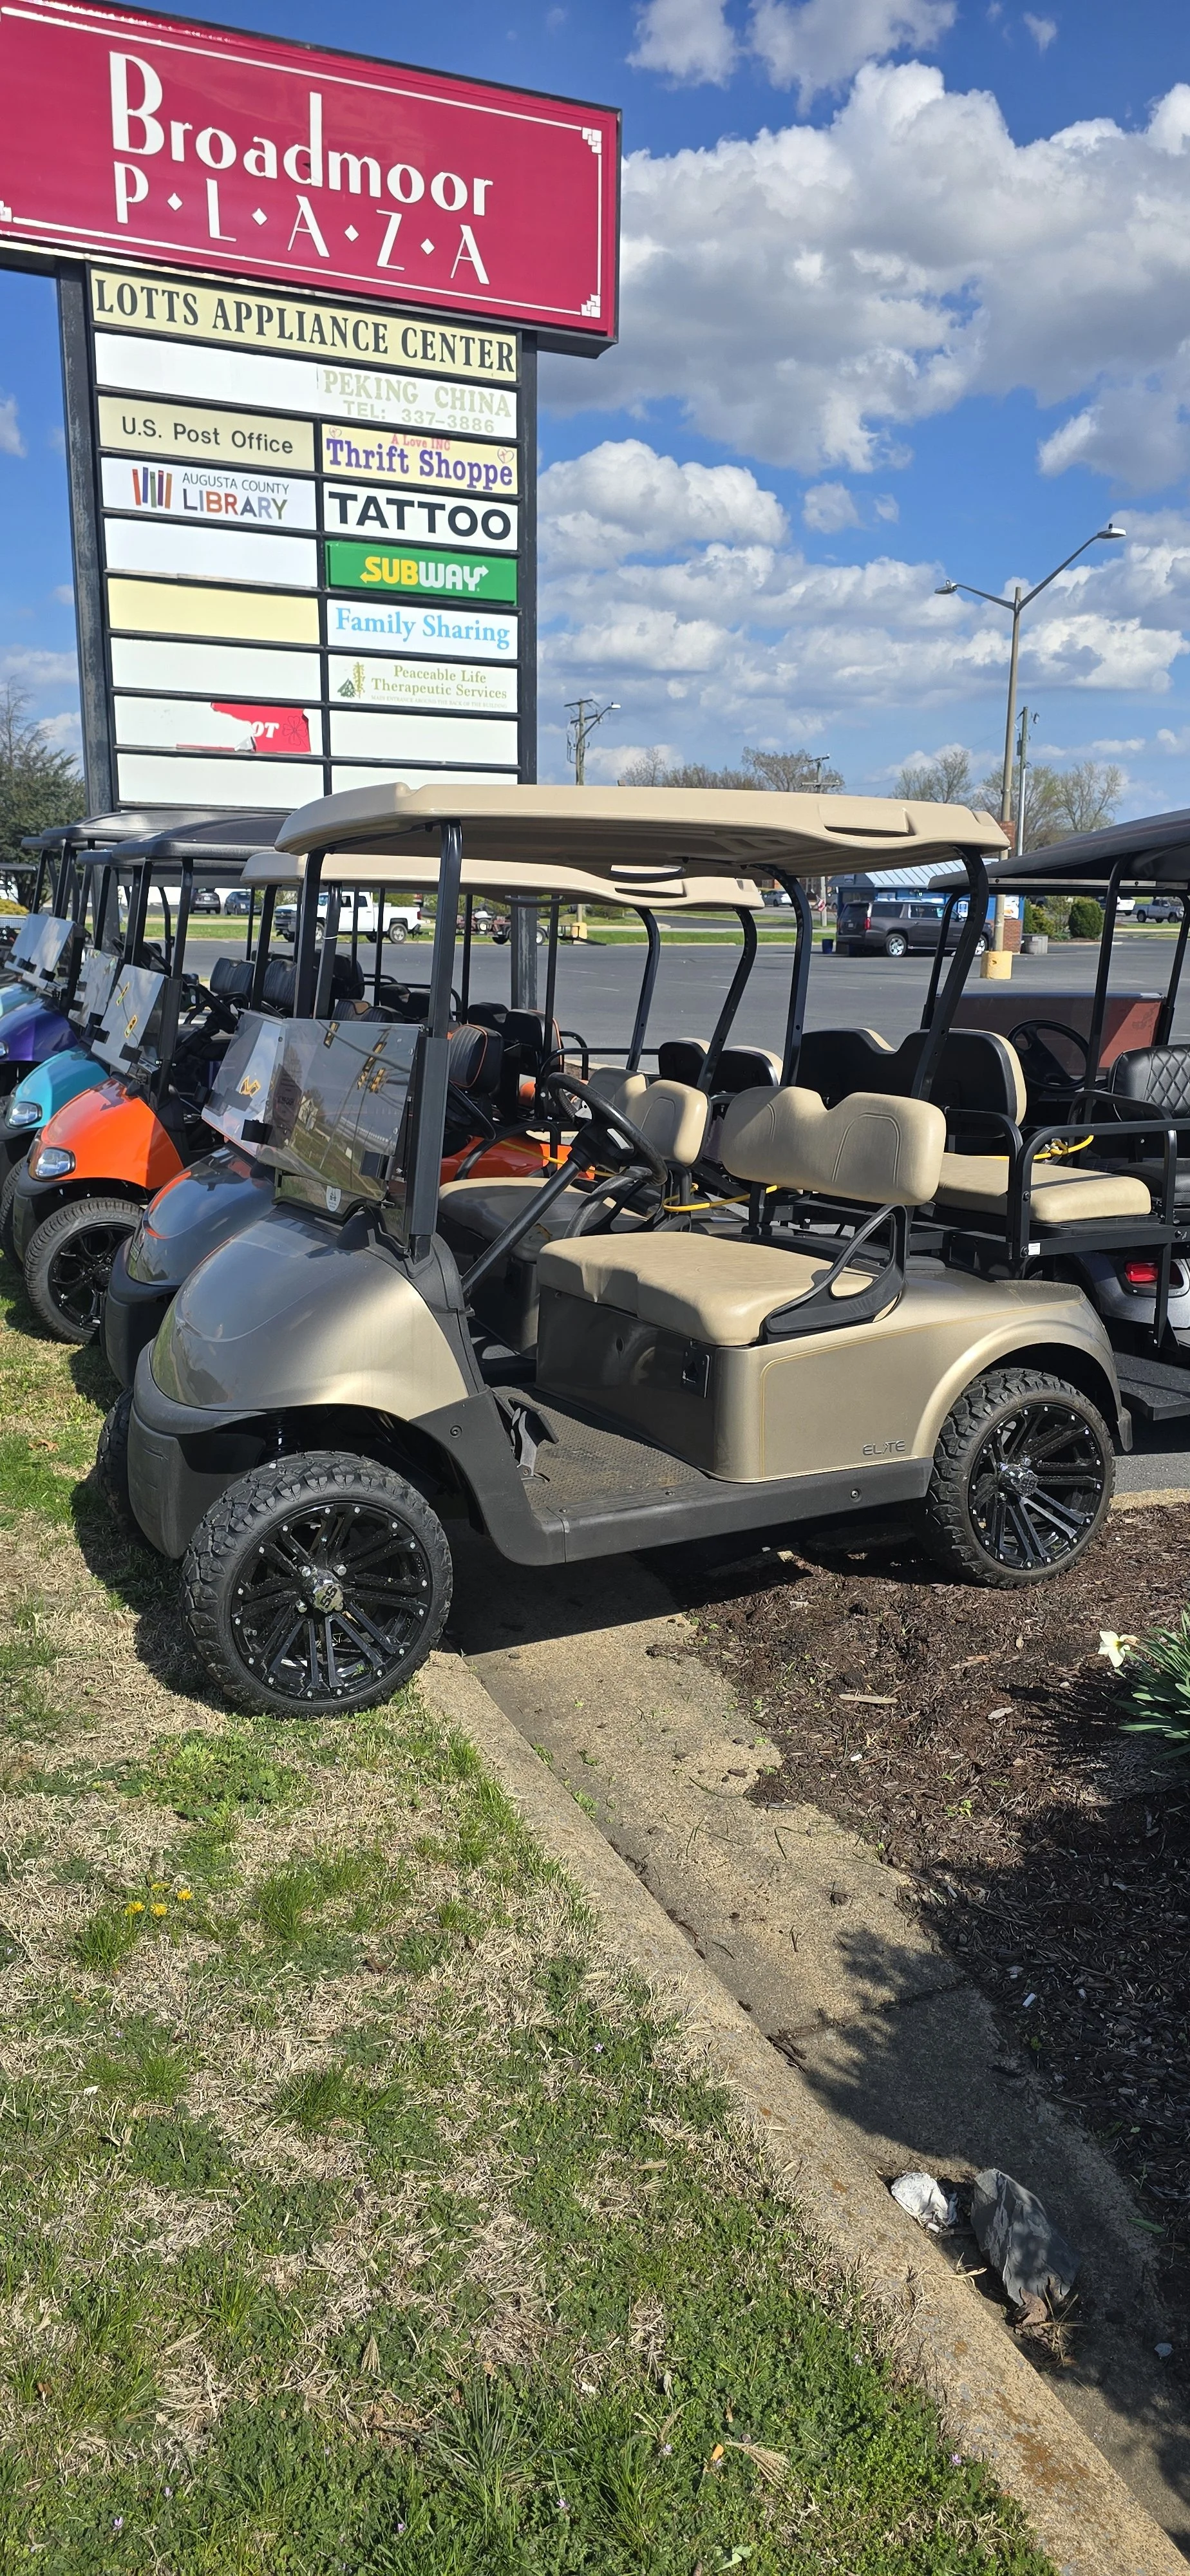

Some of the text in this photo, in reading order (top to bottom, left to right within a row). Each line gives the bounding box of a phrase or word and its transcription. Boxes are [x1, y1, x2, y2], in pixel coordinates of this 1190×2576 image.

[109, 51, 494, 217] Broadmoor
[95, 278, 515, 372] LOTTS APPLIANCE CENTER
[323, 369, 512, 418] PEKING CHINA
[343, 399, 495, 433] TEL: 337-3886
[122, 416, 294, 455] U.S. Post Office
[390, 433, 451, 451] A Love INC
[326, 438, 513, 491] Thrift Shoppe
[182, 472, 290, 495] AUGUSTA COUNTY
[182, 488, 288, 520] LIBRARY
[328, 491, 511, 540] TATTOO
[359, 555, 489, 591] SUBWAY
[335, 607, 511, 650] Family Sharing
[371, 677, 507, 699] Therapeutic Services
[393, 665, 487, 684] Peaceable Life
[862, 1440, 905, 1455] ELITE
